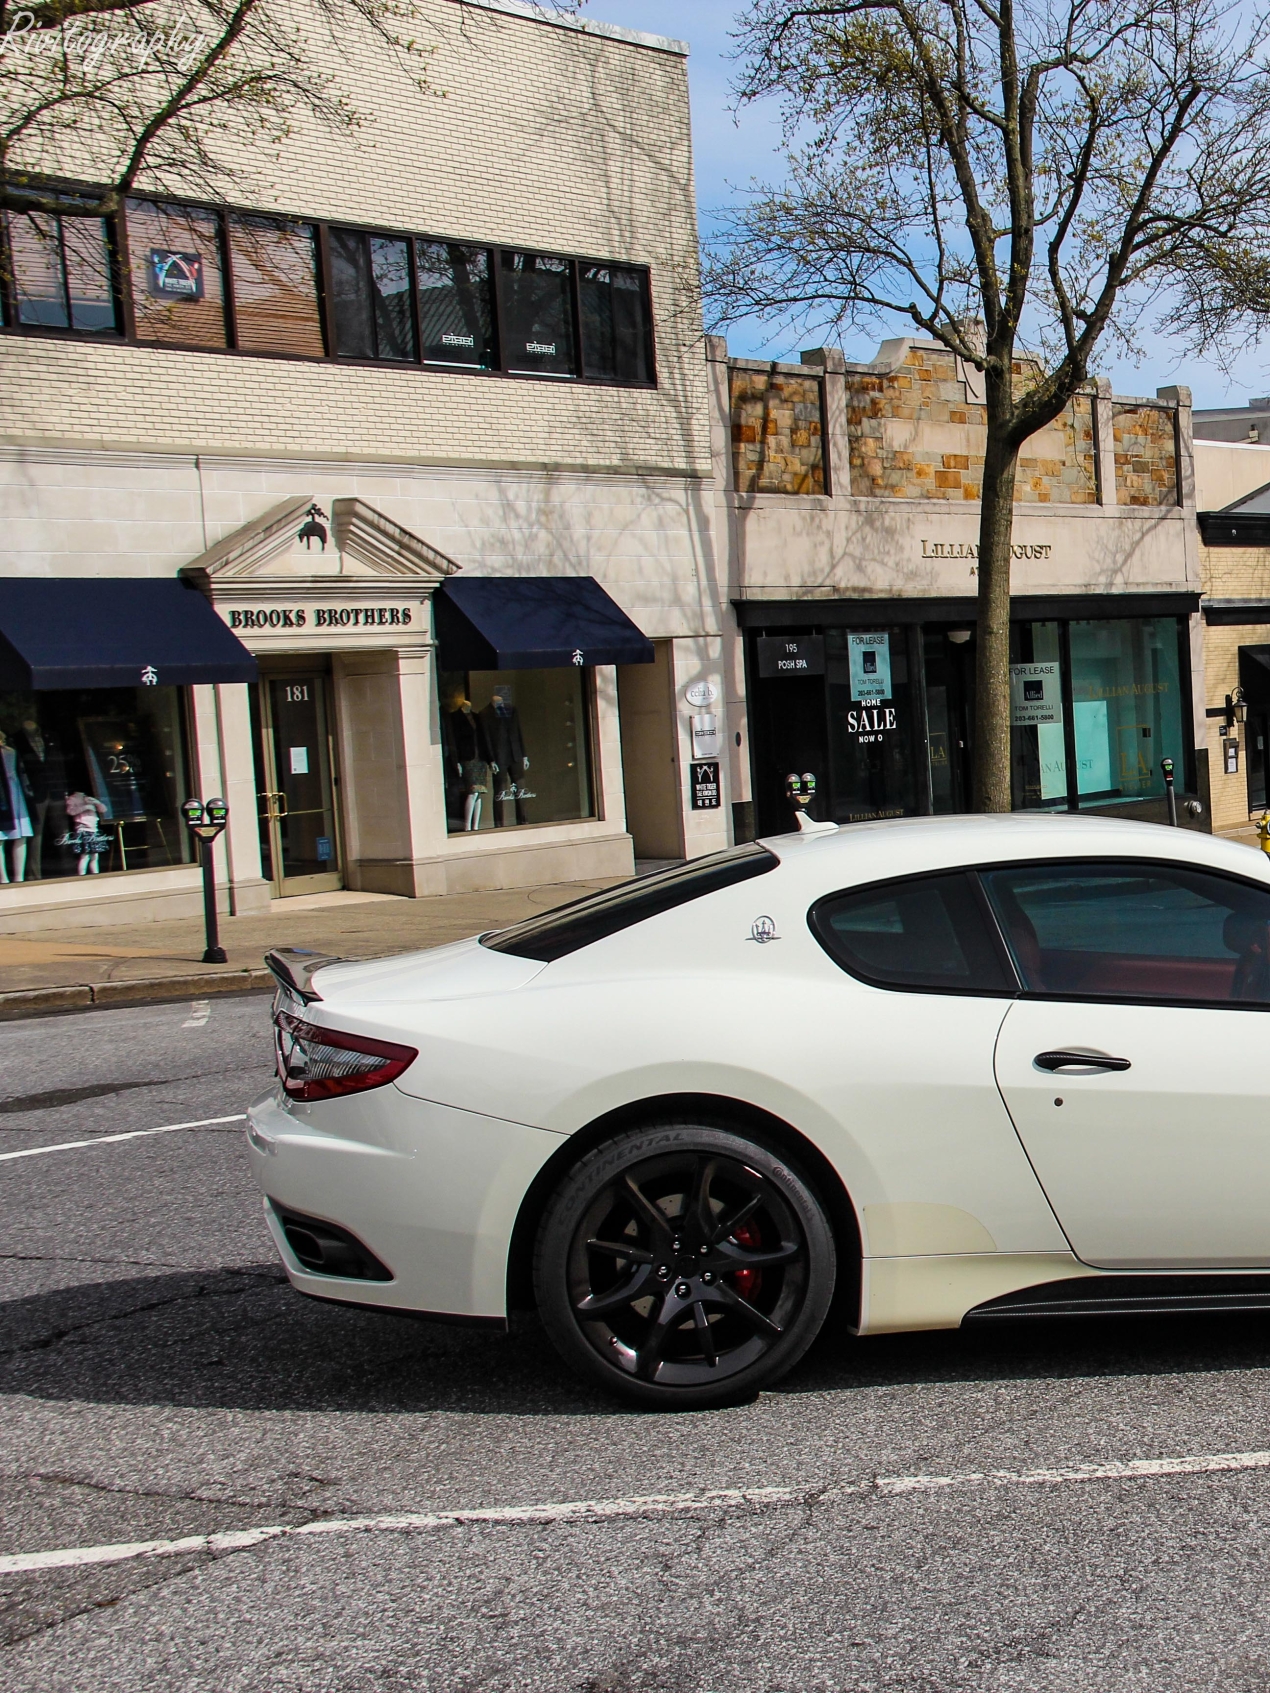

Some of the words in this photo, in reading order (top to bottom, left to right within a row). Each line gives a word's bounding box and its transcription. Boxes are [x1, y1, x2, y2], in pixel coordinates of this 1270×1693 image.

[229, 609, 306, 628] BROOKS
[313, 607, 412, 628] BROTHERS
[852, 636, 865, 645] FOR
[865, 635, 885, 645] LEASE
[785, 643, 798, 653] 195
[778, 660, 795, 670] POSH
[796, 659, 808, 669] SPA
[1009, 667, 1027, 676] FOR
[1029, 665, 1055, 675] LEASE
[285, 685, 309, 702] 181
[1025, 690, 1043, 699] Allied
[1089, 684, 1130, 699] LILLIAN
[1131, 682, 1170, 695] AUGUST
[861, 698, 881, 707] HOME
[847, 708, 897, 733] SALE
[858, 734, 875, 744] NOW
[849, 811, 877, 822] LILLIAN
[877, 808, 905, 819] AUGUST
